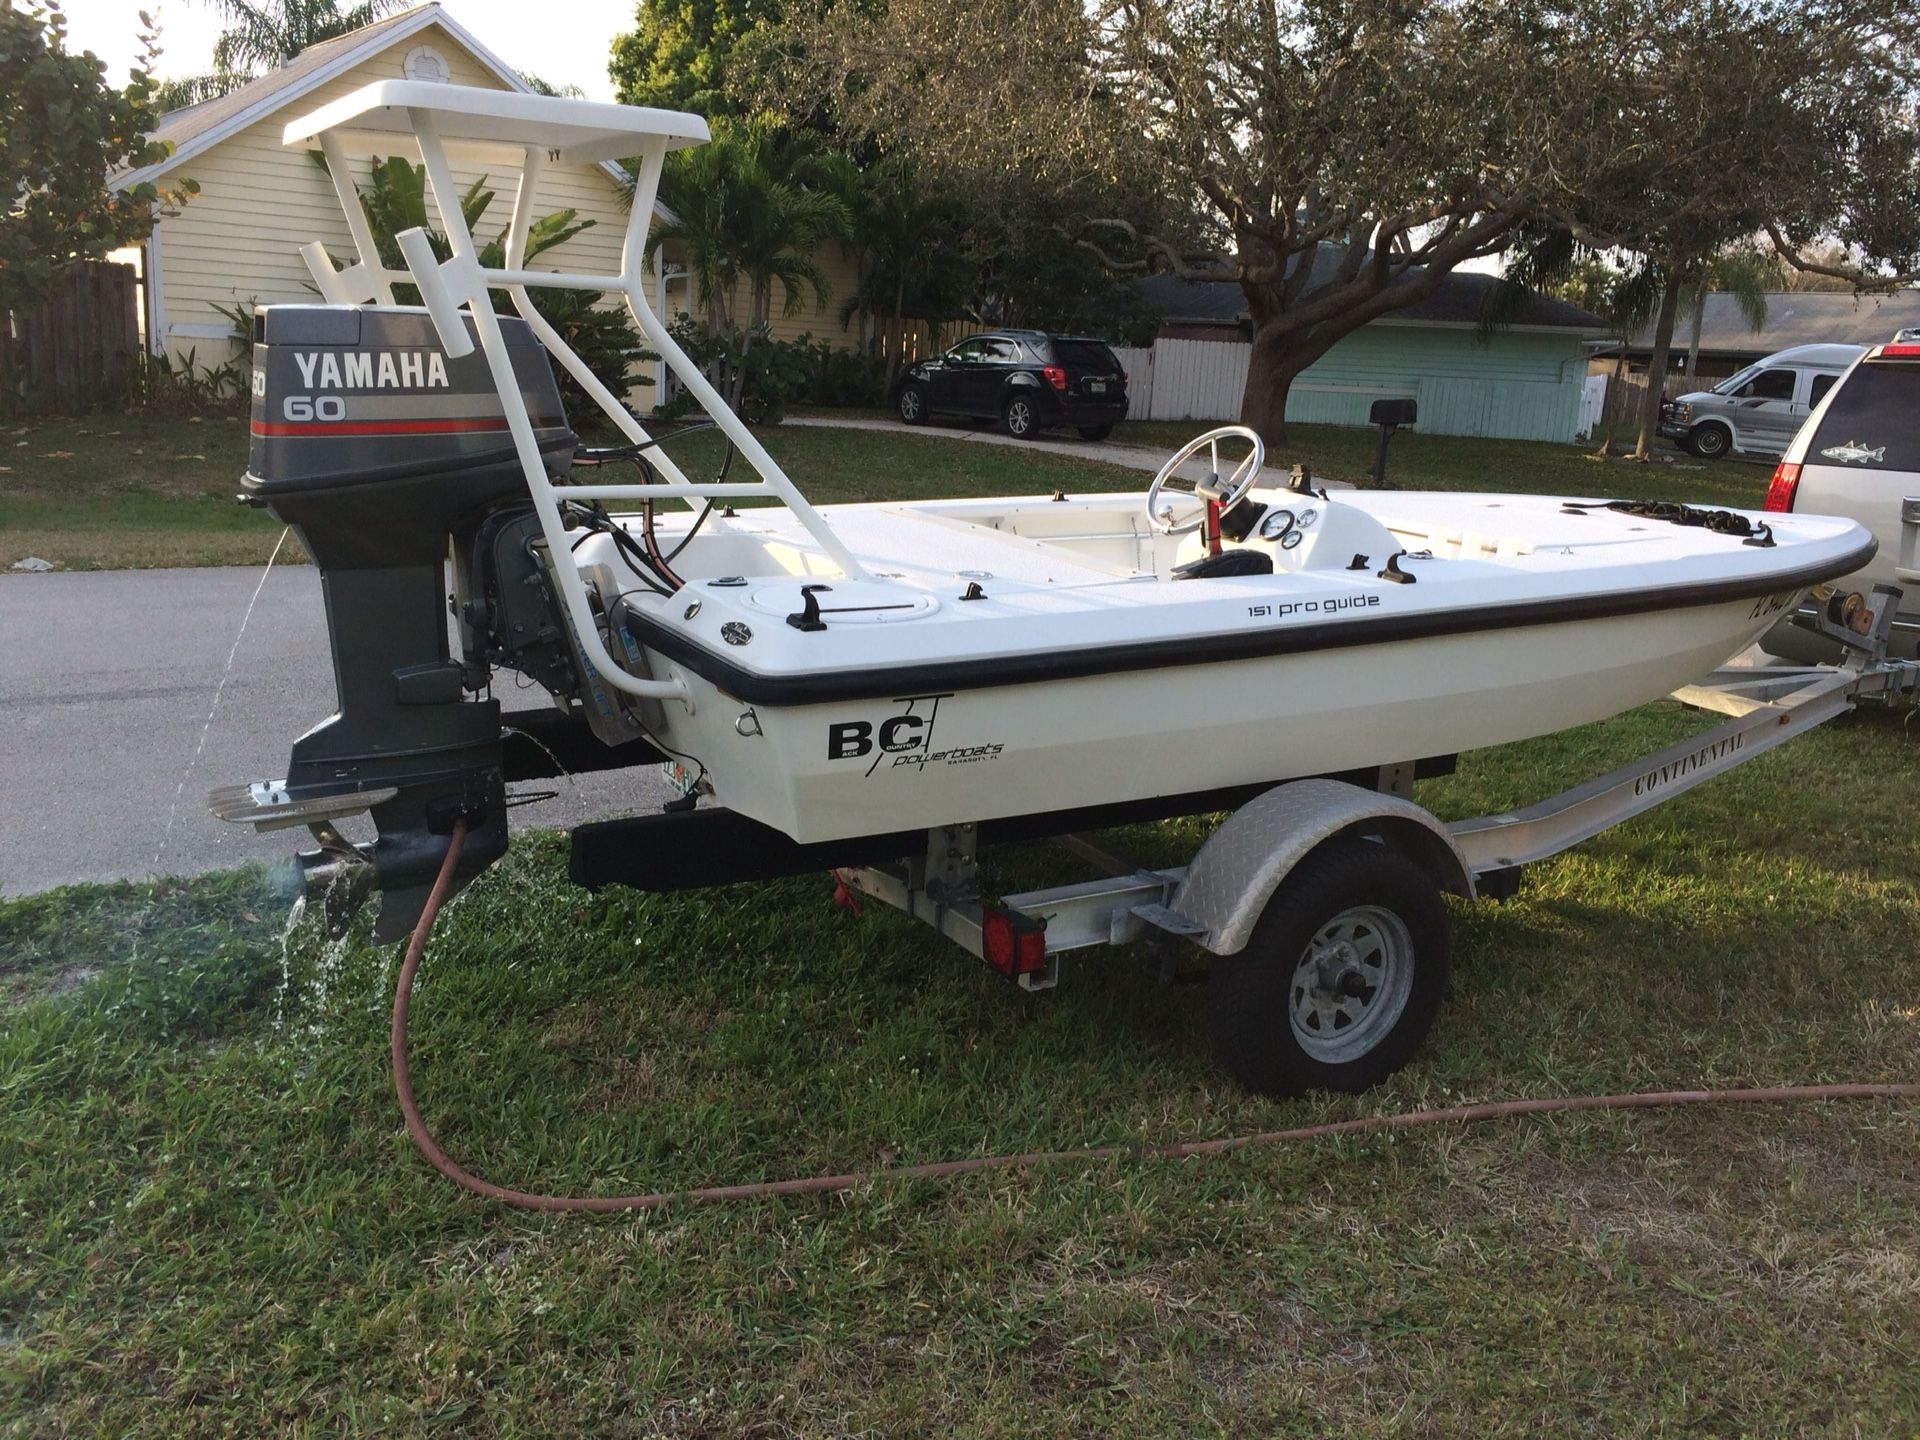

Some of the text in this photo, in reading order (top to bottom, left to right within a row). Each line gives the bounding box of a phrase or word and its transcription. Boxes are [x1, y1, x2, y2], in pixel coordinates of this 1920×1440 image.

[294, 352, 450, 389] YAMAHA
[283, 396, 346, 422] 60
[1248, 594, 1380, 617] 151 pro guide
[892, 743, 1004, 768] powerboats
[1634, 732, 1744, 796] CONTINENTAL
